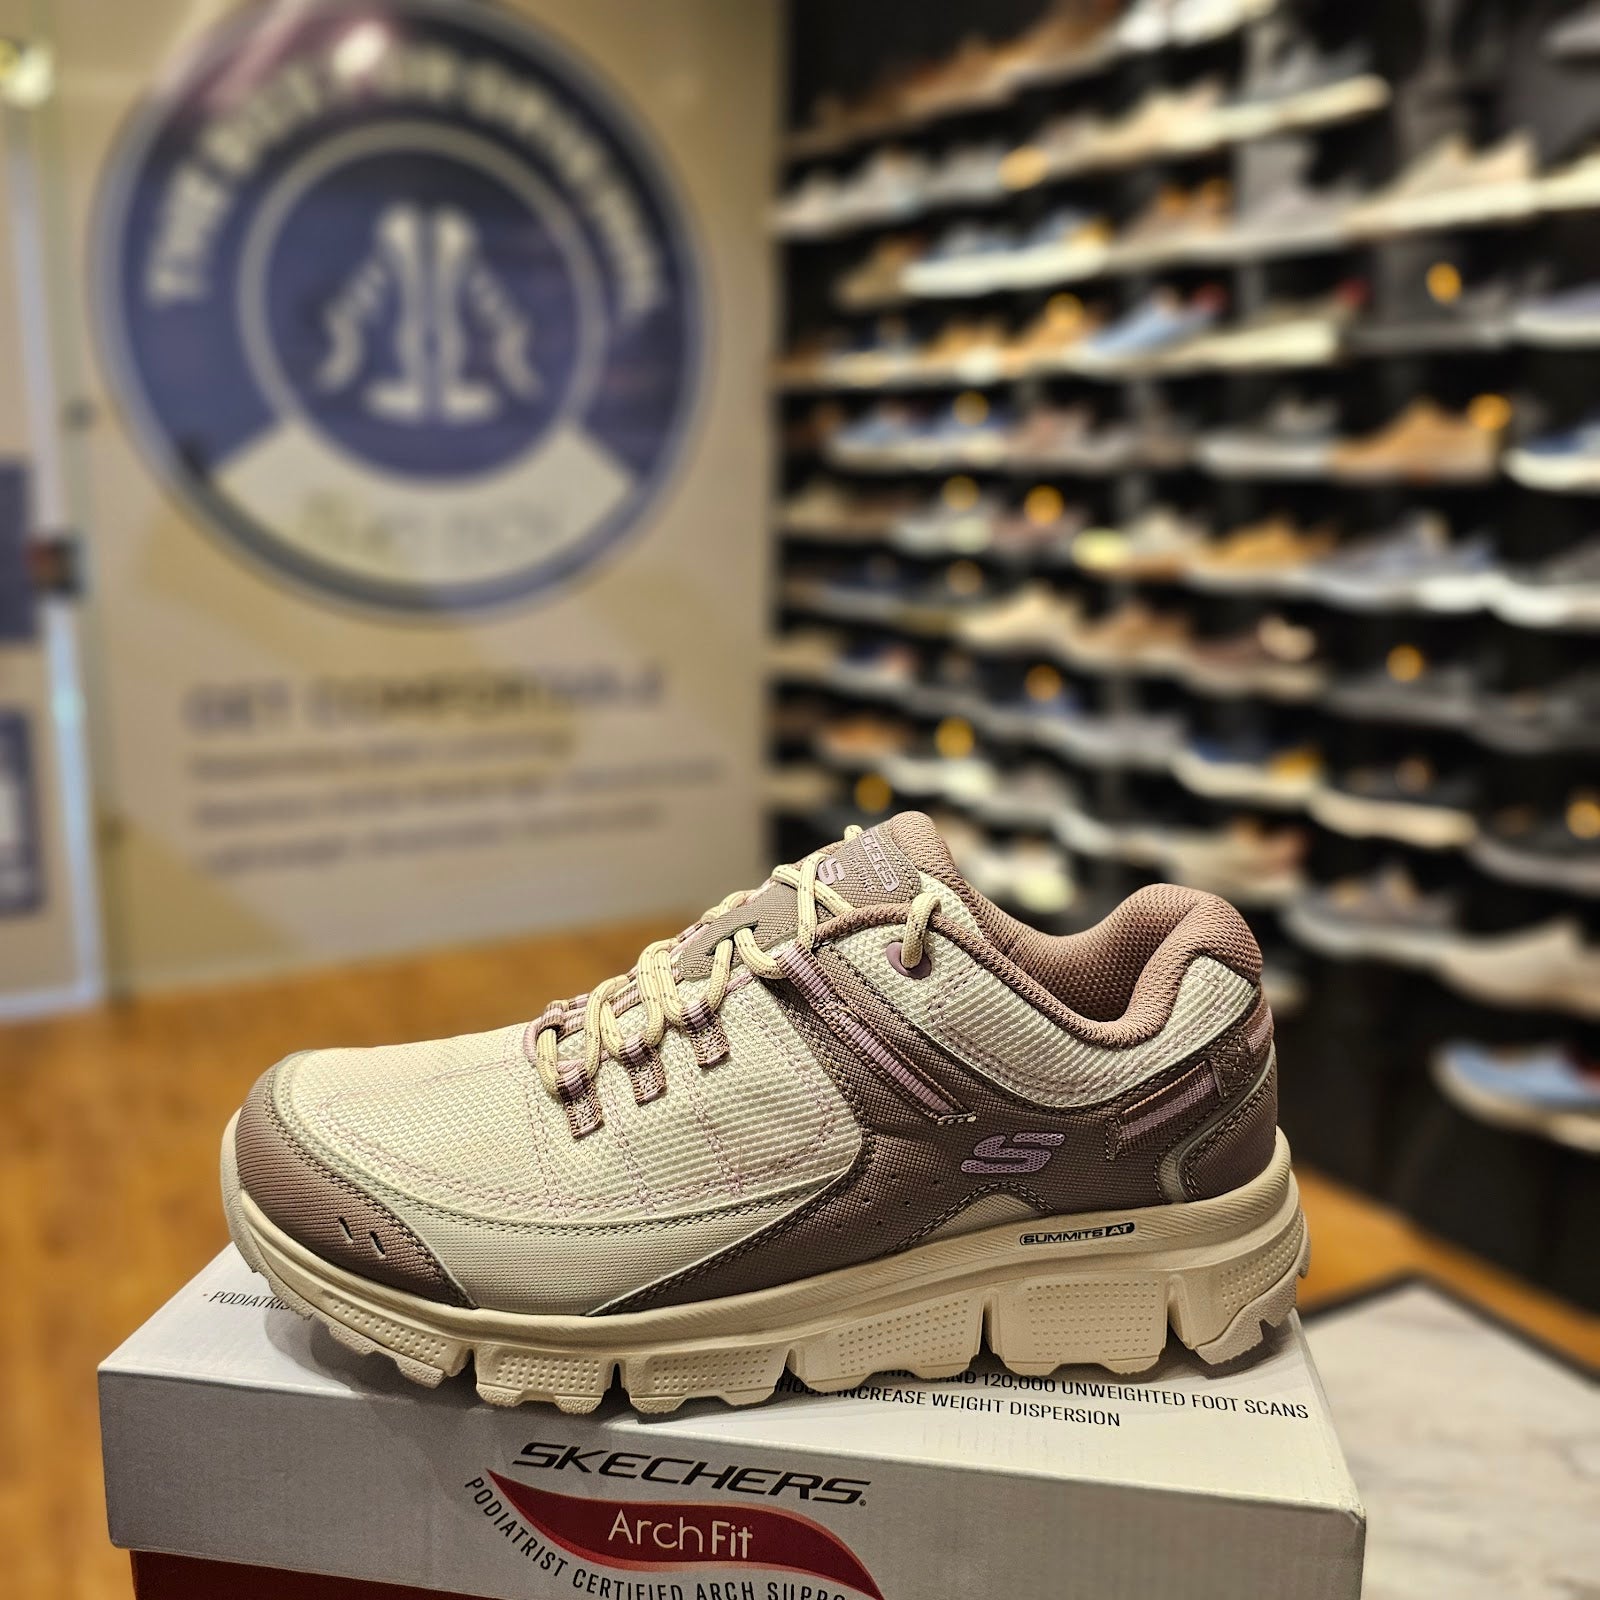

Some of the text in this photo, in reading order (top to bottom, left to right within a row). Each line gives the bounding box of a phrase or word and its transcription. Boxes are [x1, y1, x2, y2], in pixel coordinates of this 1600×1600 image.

[1022, 1223, 1131, 1244] SUMMITS AT
[932, 1393, 1005, 1413] WEIGHT
[1010, 1401, 1121, 1427] DISPERSION
[983, 1373, 1056, 1393] 120,000
[1061, 1380, 1187, 1406] UNWEIGHTED
[1191, 1394, 1239, 1412] FOOT
[1244, 1399, 1309, 1419] SCANS
[464, 1476, 569, 1577] PODIATRIST
[572, 1567, 684, 1600] CERTIFIED
[696, 1581, 755, 1600] ARCH
